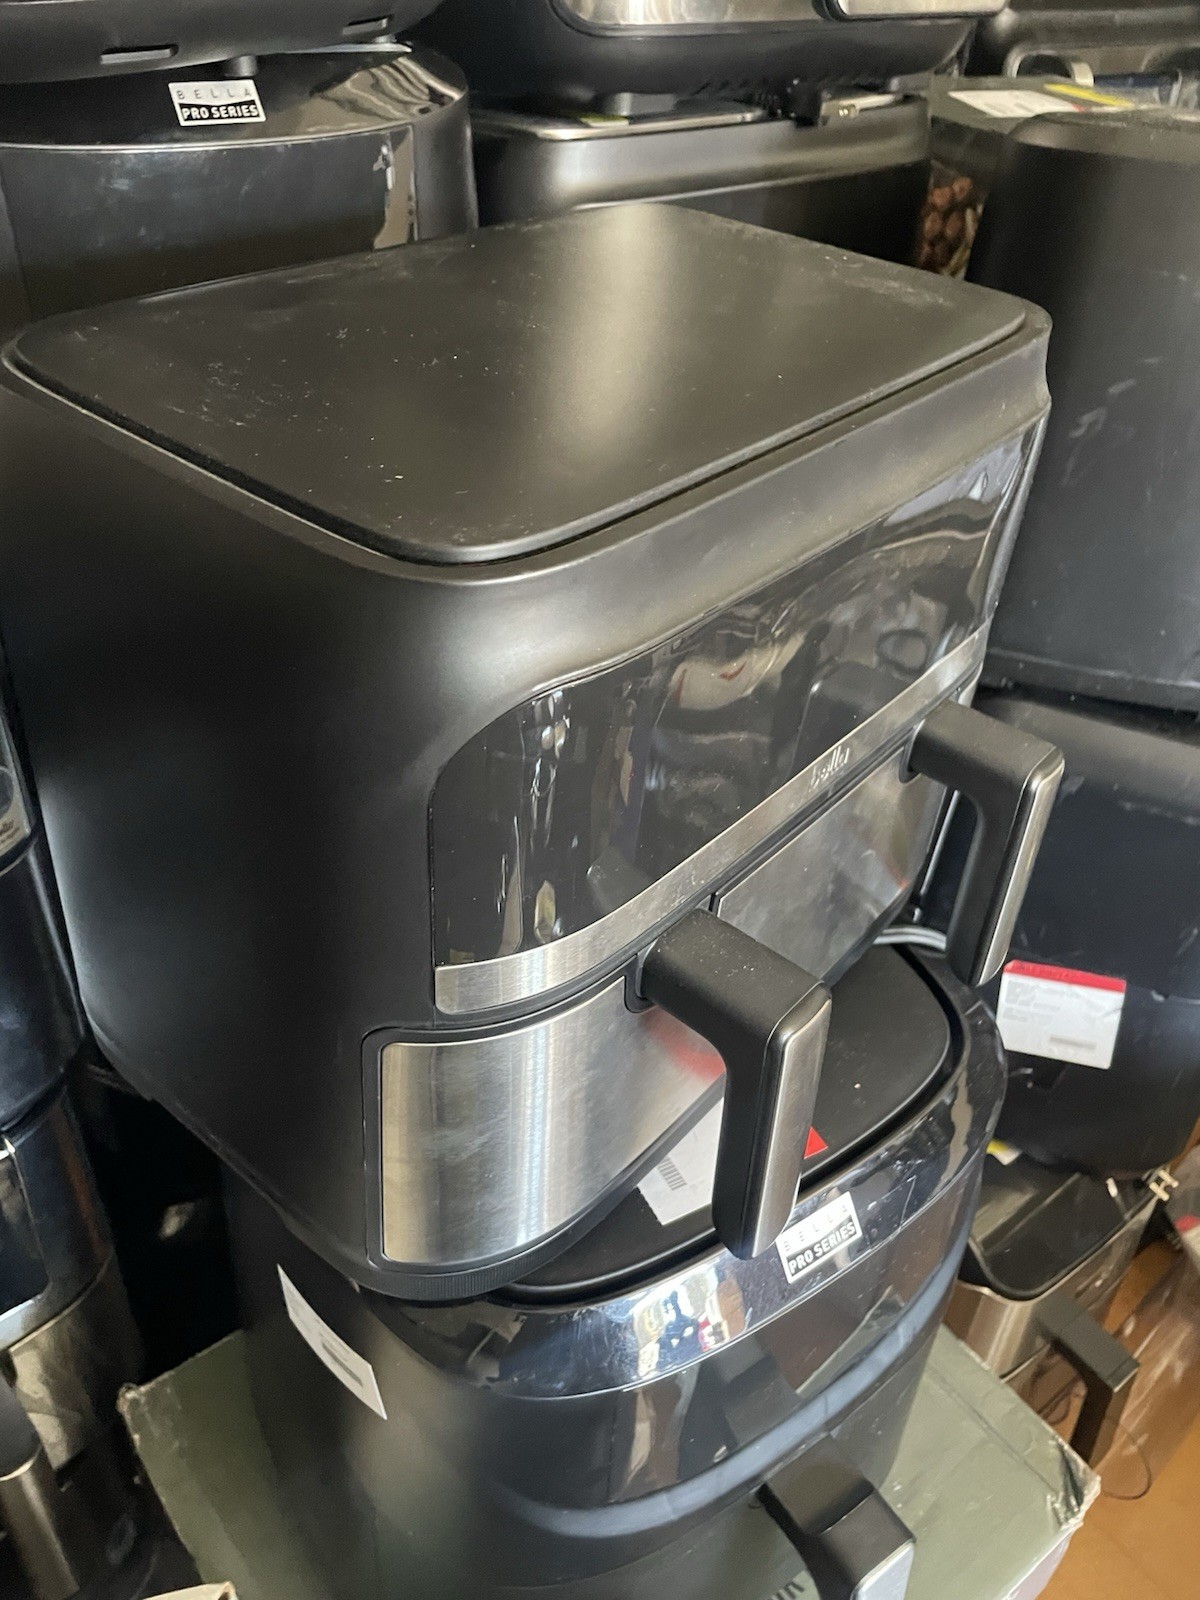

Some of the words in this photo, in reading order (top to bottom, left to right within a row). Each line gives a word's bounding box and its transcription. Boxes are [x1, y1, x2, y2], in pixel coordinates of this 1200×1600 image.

[177, 88, 252, 99] BELLA
[181, 107, 209, 120] PRO
[211, 104, 259, 117] SERIES
[783, 1204, 848, 1252] BELLA
[788, 1249, 814, 1275] PRO
[813, 1221, 857, 1257] SERIES
